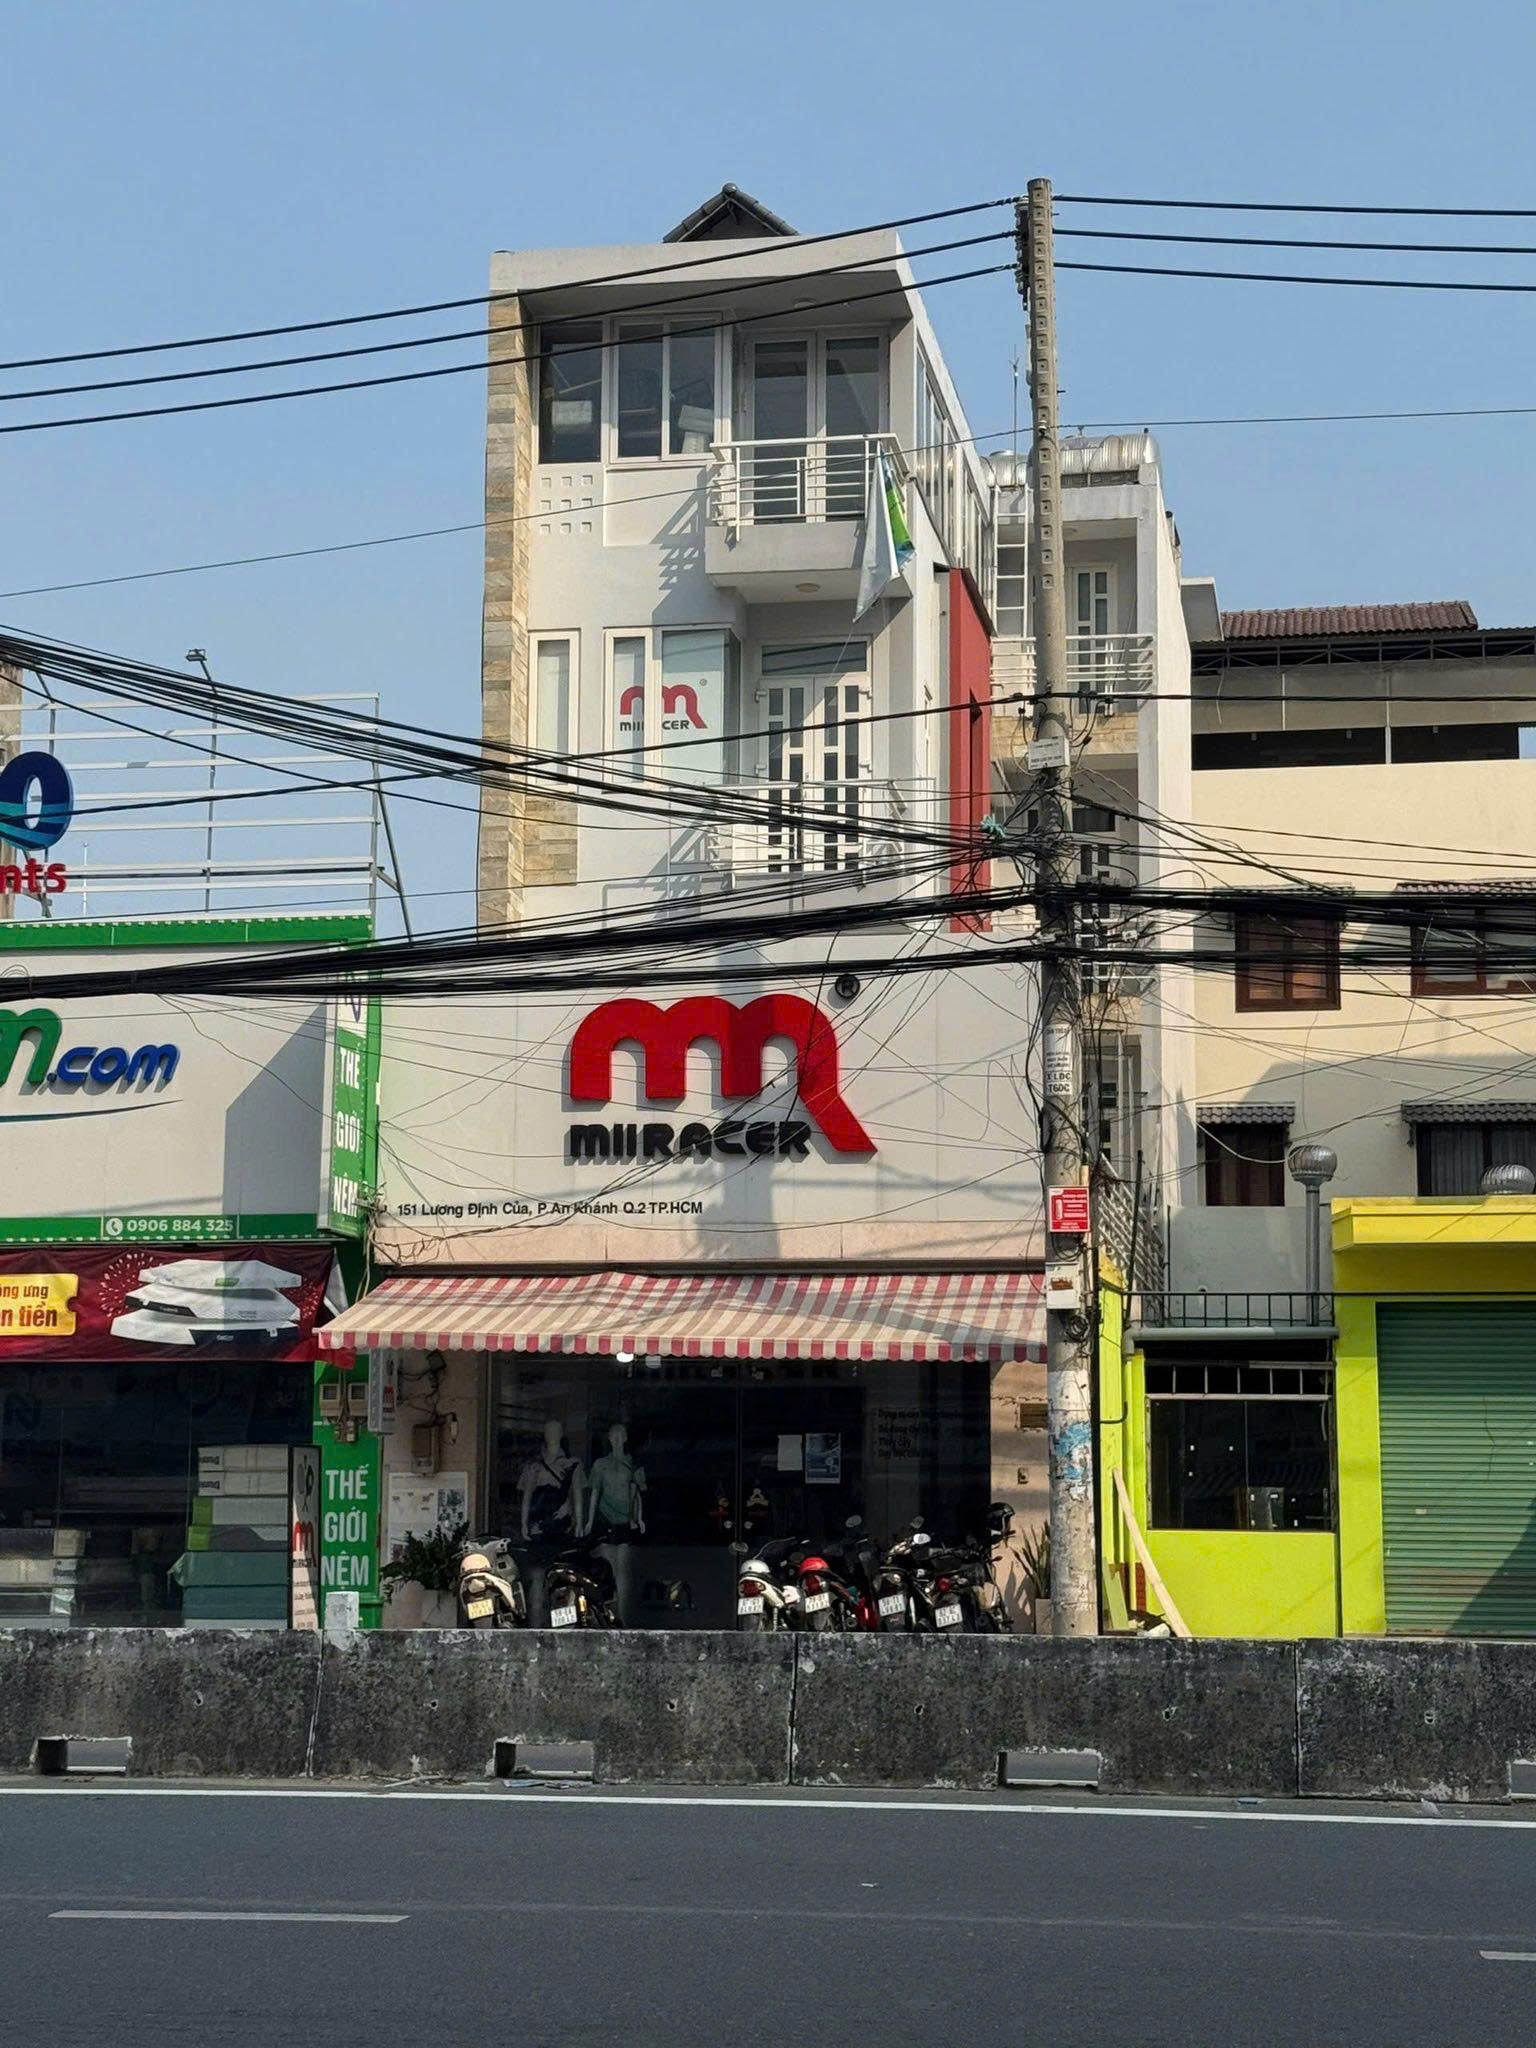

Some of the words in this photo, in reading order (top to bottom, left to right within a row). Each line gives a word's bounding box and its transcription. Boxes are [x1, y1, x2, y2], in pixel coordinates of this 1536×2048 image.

[0, 858, 67, 893] nts
[570, 1120, 812, 1157] MIIRACER
[126, 1219, 168, 1232] 0906
[172, 1219, 201, 1232] 884
[205, 1219, 234, 1232] 325
[398, 1203, 417, 1216] 151
[421, 1203, 464, 1218] Lương
[467, 1202, 498, 1218] Định
[502, 1200, 533, 1217] Của,
[622, 1201, 646, 1215] Q.2
[649, 1201, 703, 1215] TP.HCM
[0, 1284, 19, 1299] ng
[19, 1301, 58, 1327] tiền
[325, 1463, 370, 1500] THẾ
[324, 1506, 368, 1543] GIỚI
[321, 1550, 370, 1590] NỆM
